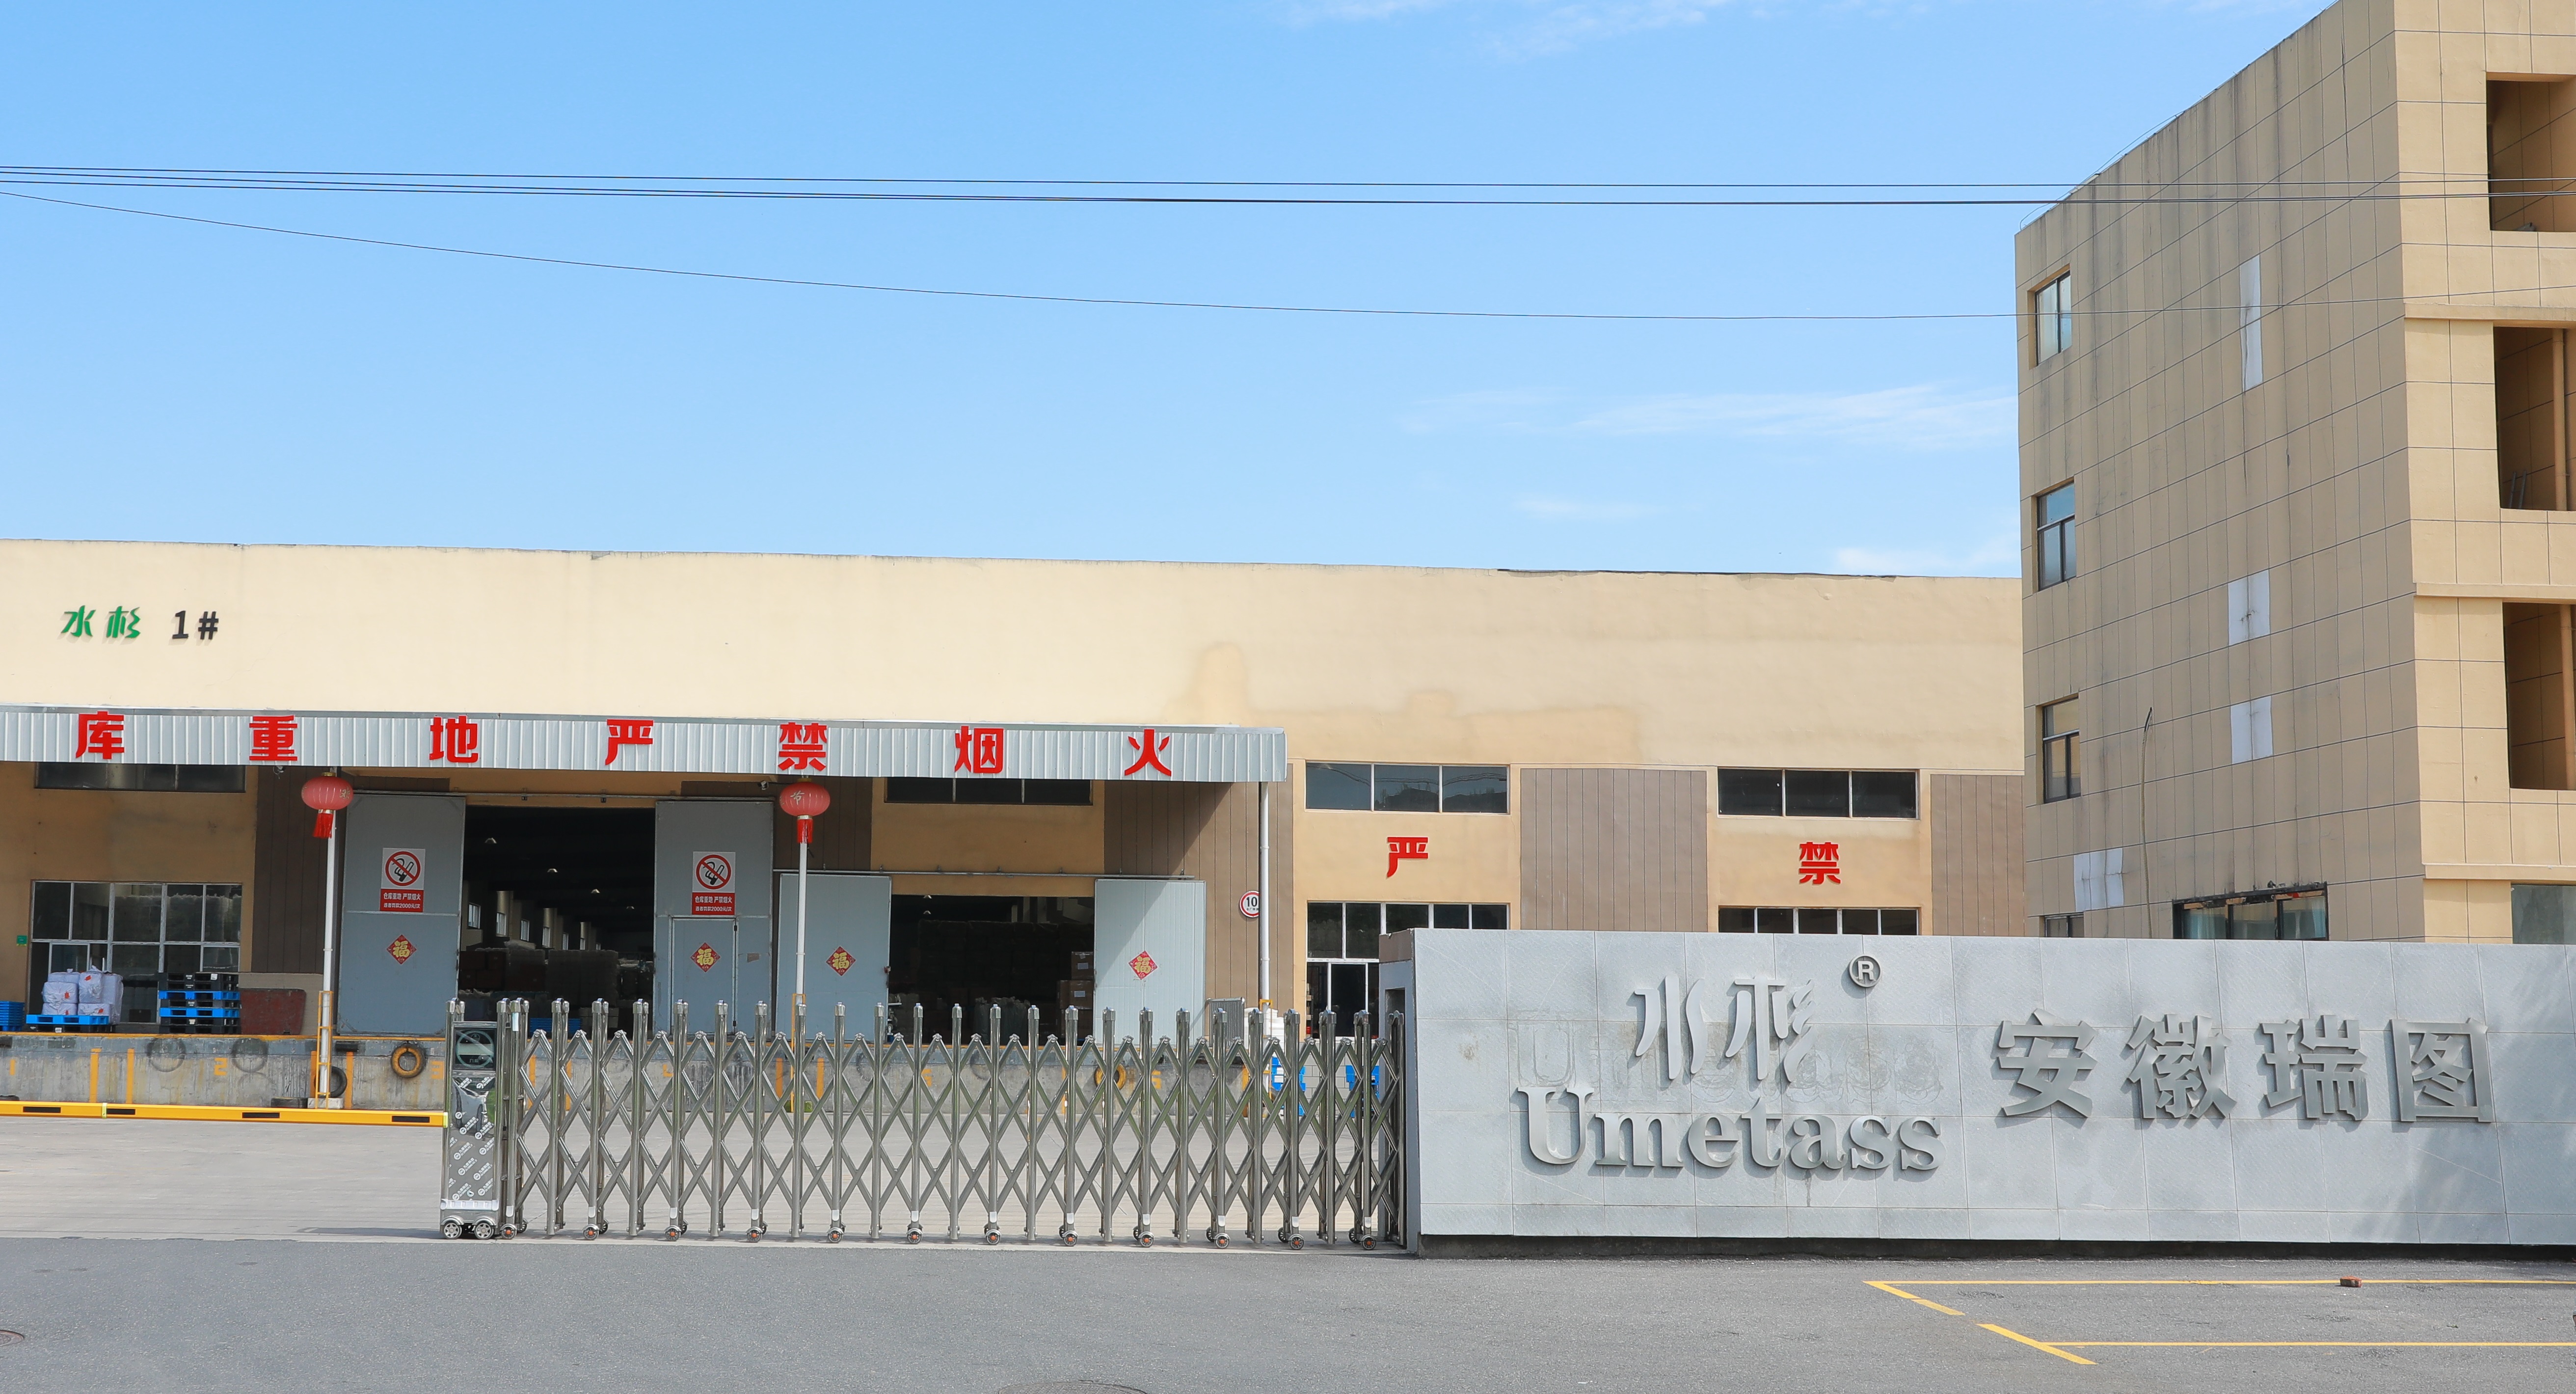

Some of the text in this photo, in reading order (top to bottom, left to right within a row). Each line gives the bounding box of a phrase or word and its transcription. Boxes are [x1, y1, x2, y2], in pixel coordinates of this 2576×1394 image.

[61, 605, 219, 640] 水杉 1#
[1387, 837, 1428, 878] 严
[1798, 842, 1841, 885] 禁
[1246, 897, 1258, 907] 10
[393, 940, 410, 957] 福
[697, 948, 715, 965] 福
[832, 952, 850, 970] 福
[1134, 956, 1152, 974] 福
[214, 1057, 228, 1076] 2
[1997, 1009, 2496, 1123] 安徽瑞图
[1517, 1086, 1947, 1171] Umetass
